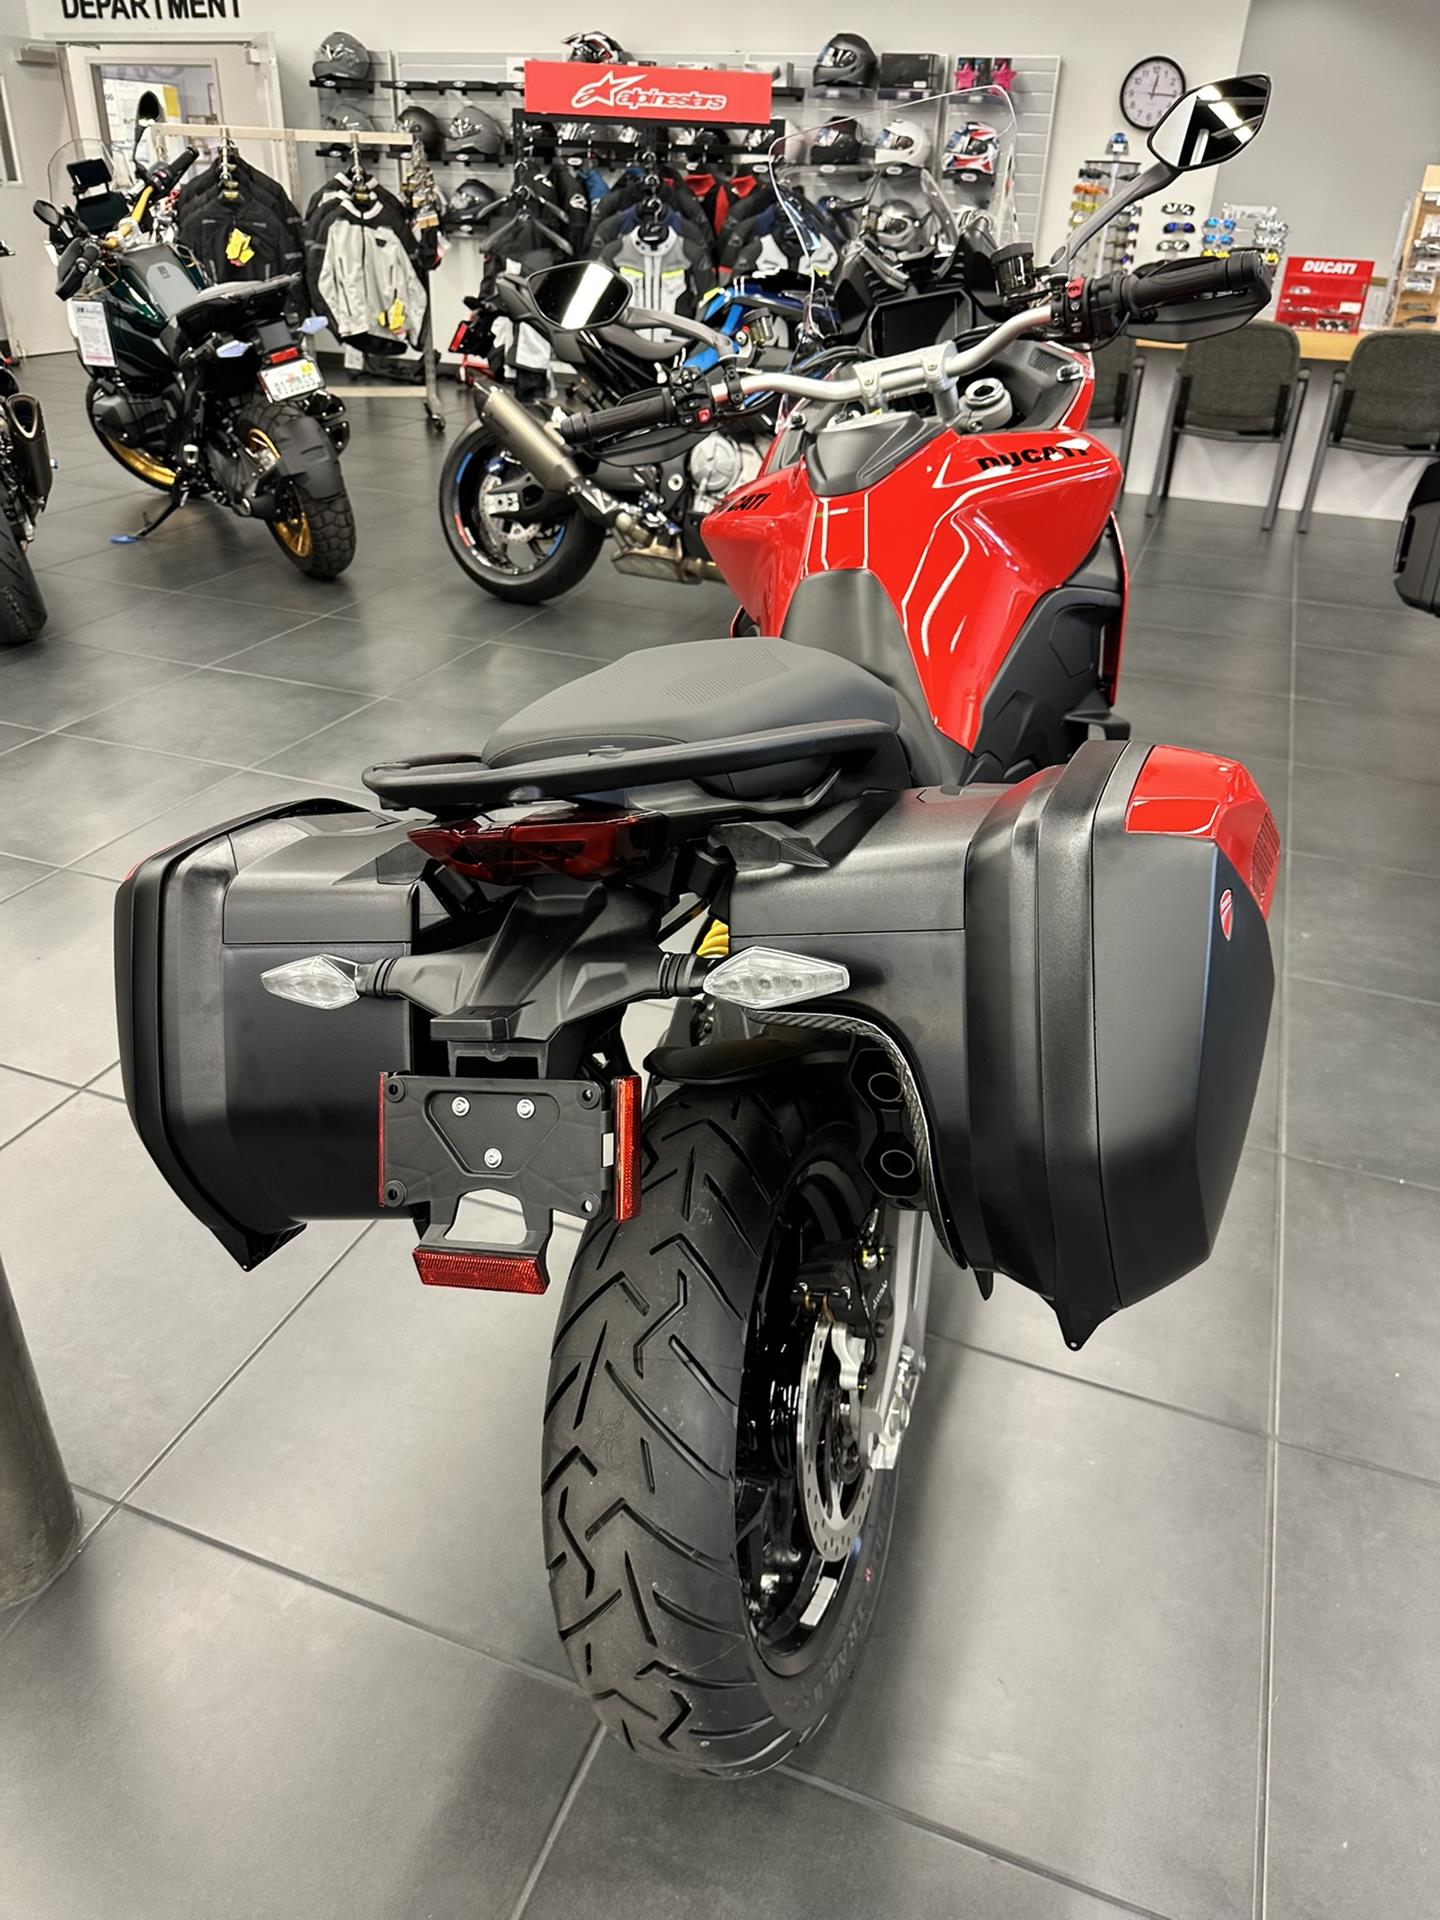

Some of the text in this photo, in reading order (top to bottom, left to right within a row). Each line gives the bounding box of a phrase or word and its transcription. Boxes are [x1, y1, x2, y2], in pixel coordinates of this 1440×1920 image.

[61, 0, 240, 20] DEPARTMENT
[615, 87, 728, 110] alpinestars
[1302, 260, 1357, 275] DUCATI
